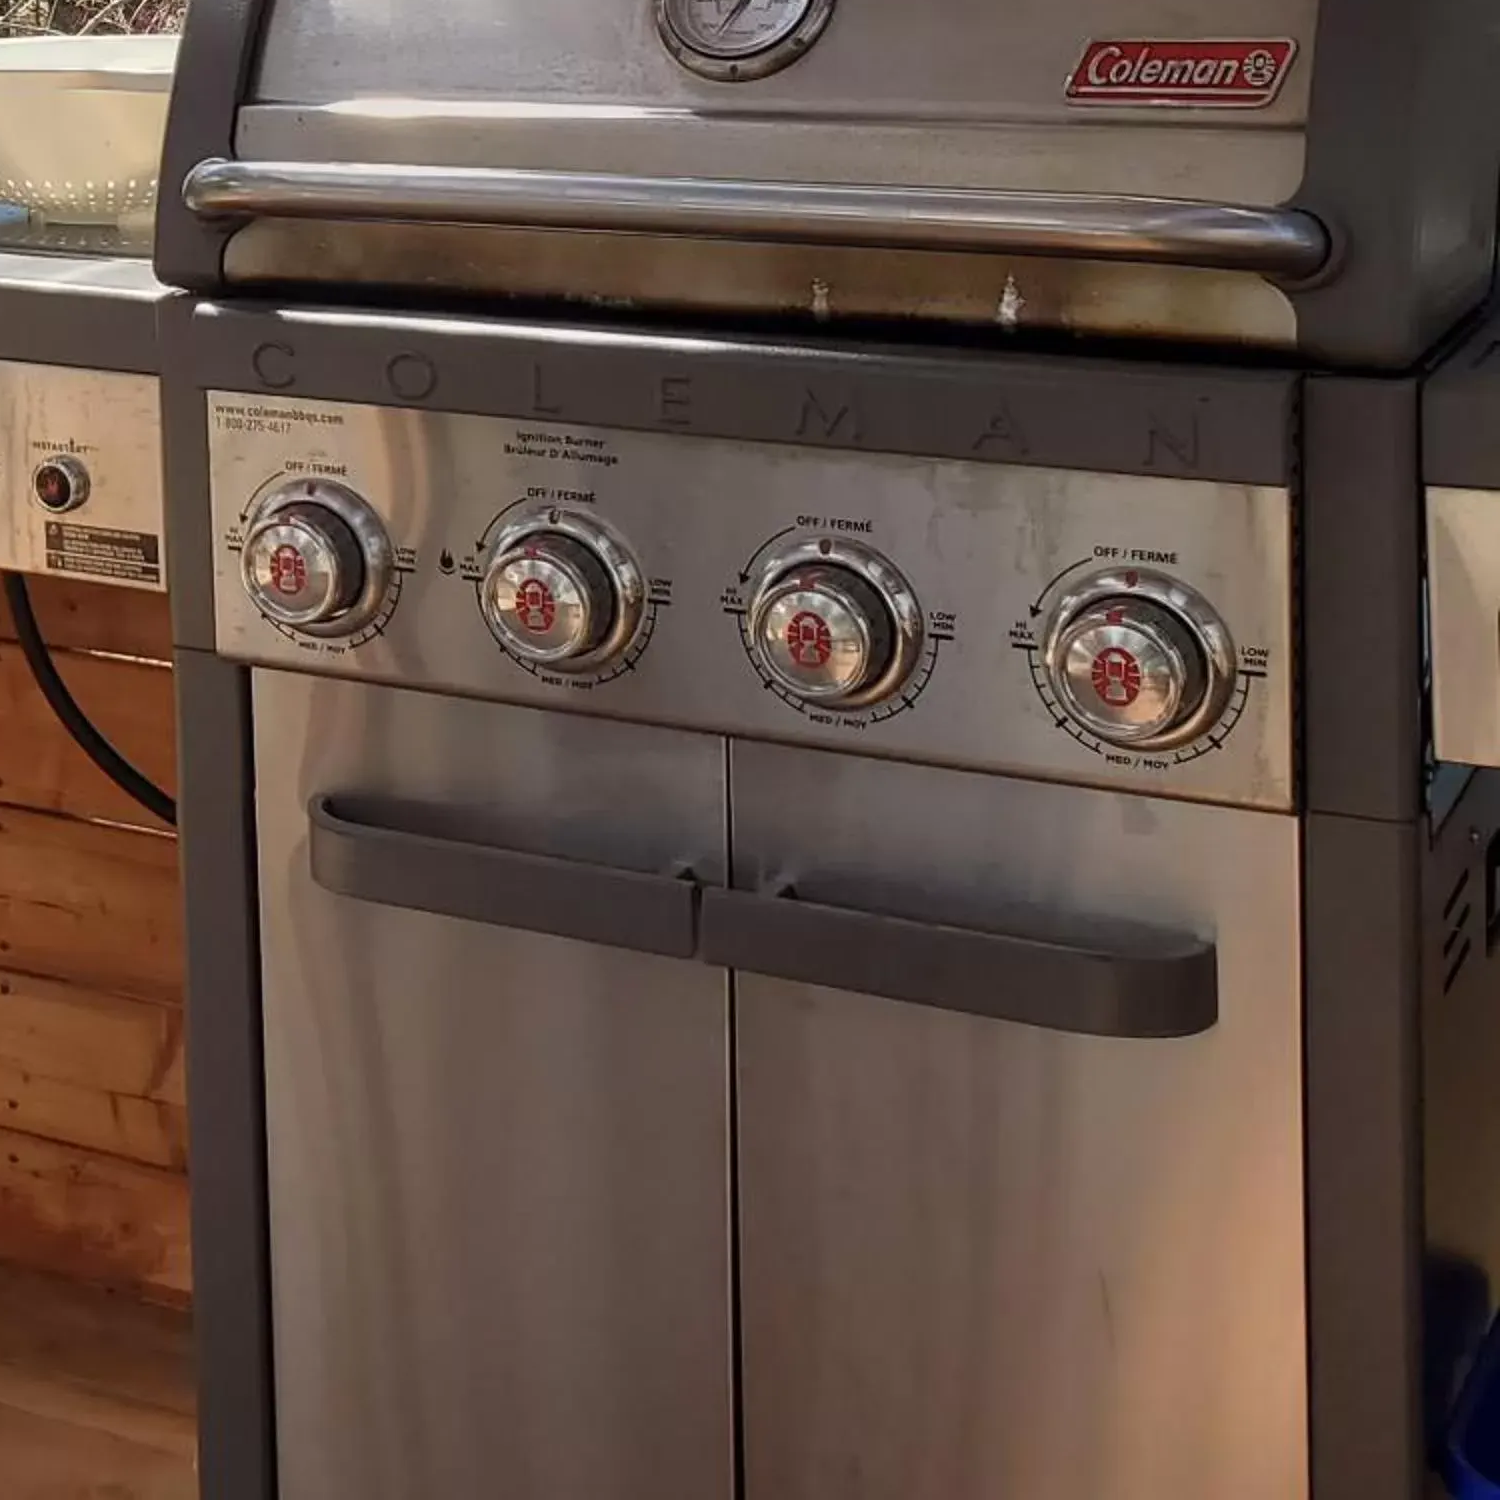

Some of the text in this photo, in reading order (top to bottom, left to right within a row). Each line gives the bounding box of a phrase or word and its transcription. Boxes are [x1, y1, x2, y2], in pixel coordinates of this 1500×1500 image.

[1087, 47, 1240, 85] Coleman
[516, 430, 604, 449] Ignition Burner
[285, 461, 305, 471] OFF
[527, 486, 546, 498] OFF
[796, 515, 821, 528] OFF
[830, 518, 873, 533] FERMÉ
[1093, 546, 1119, 558] OFF
[1130, 548, 1178, 565] FERMÉ
[460, 563, 481, 573] MAX
[649, 579, 673, 588] LOW
[720, 595, 743, 606] MAX
[929, 611, 957, 622] LOW
[1015, 621, 1028, 630] HI
[1009, 629, 1035, 641] MAX
[1241, 647, 1269, 658] LOW
[1243, 656, 1268, 668] MIN
[809, 713, 834, 725] MED
[843, 717, 868, 730] MOY
[1105, 754, 1132, 766] MED
[1142, 758, 1169, 771] MOY
